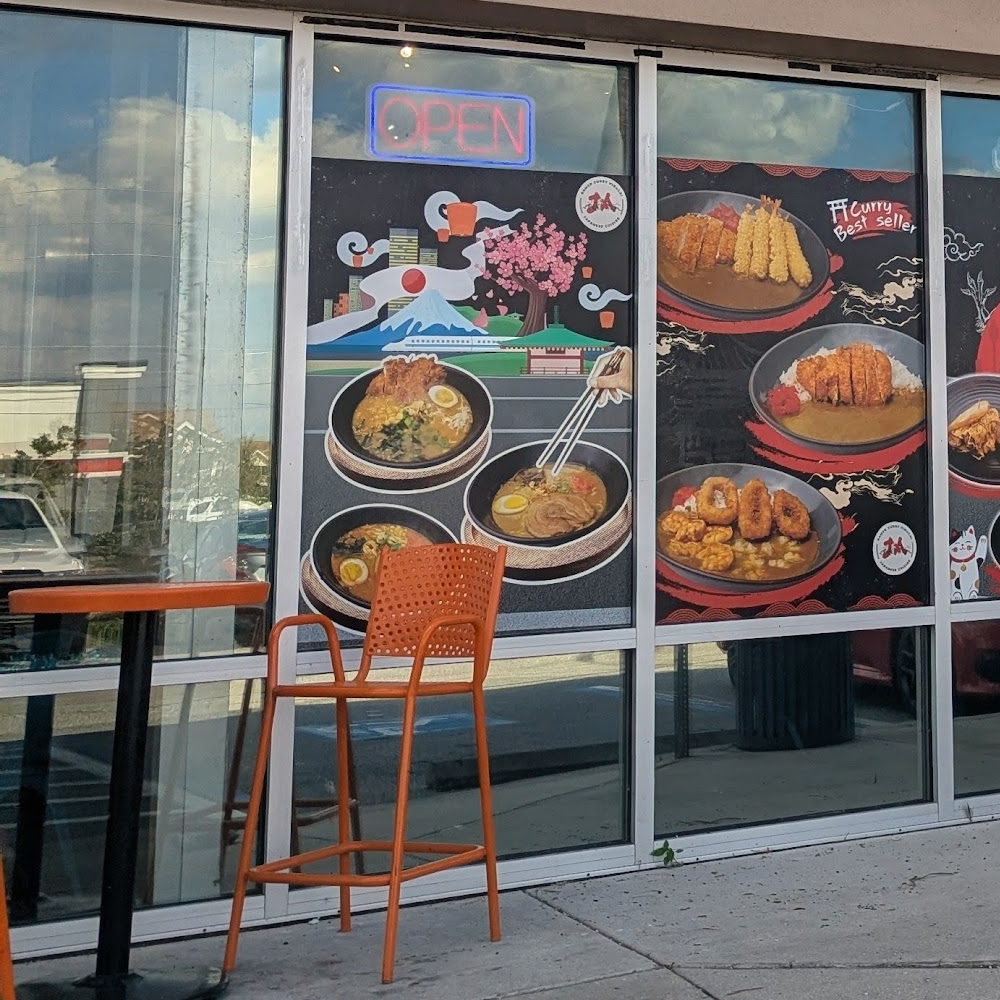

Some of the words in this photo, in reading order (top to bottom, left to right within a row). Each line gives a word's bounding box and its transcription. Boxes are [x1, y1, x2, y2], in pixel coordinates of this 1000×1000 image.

[379, 96, 525, 156] OPEN
[587, 192, 617, 214] JA
[850, 201, 892, 215] Curry
[833, 216, 868, 242] Best
[876, 213, 917, 234] seller
[883, 537, 908, 559] JA
